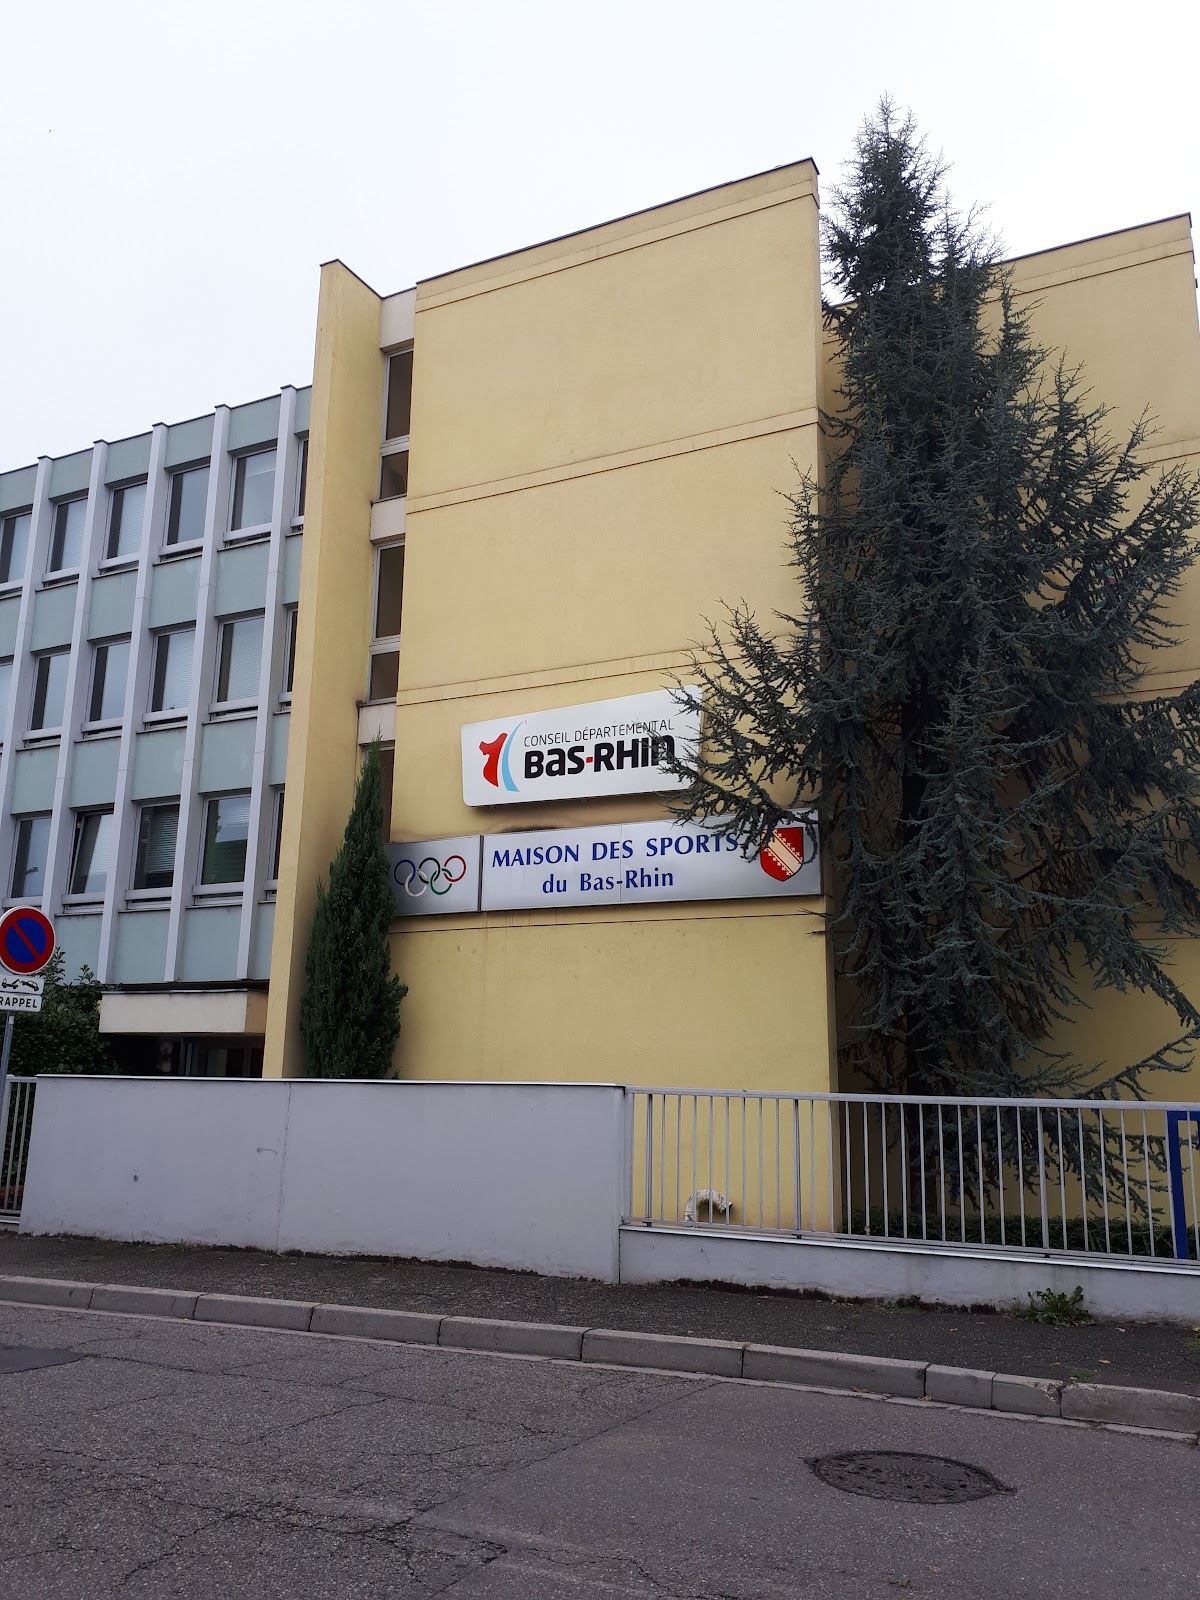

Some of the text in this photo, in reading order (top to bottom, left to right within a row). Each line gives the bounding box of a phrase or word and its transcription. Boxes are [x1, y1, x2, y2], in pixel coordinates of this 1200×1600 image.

[524, 719, 674, 747] CONSEIL DÉPARTEMENTAL
[492, 832, 738, 868] MAISON DES SPORTS
[542, 868, 674, 895] du Bas-Rhin
[0, 996, 37, 1008] RAPPEL
